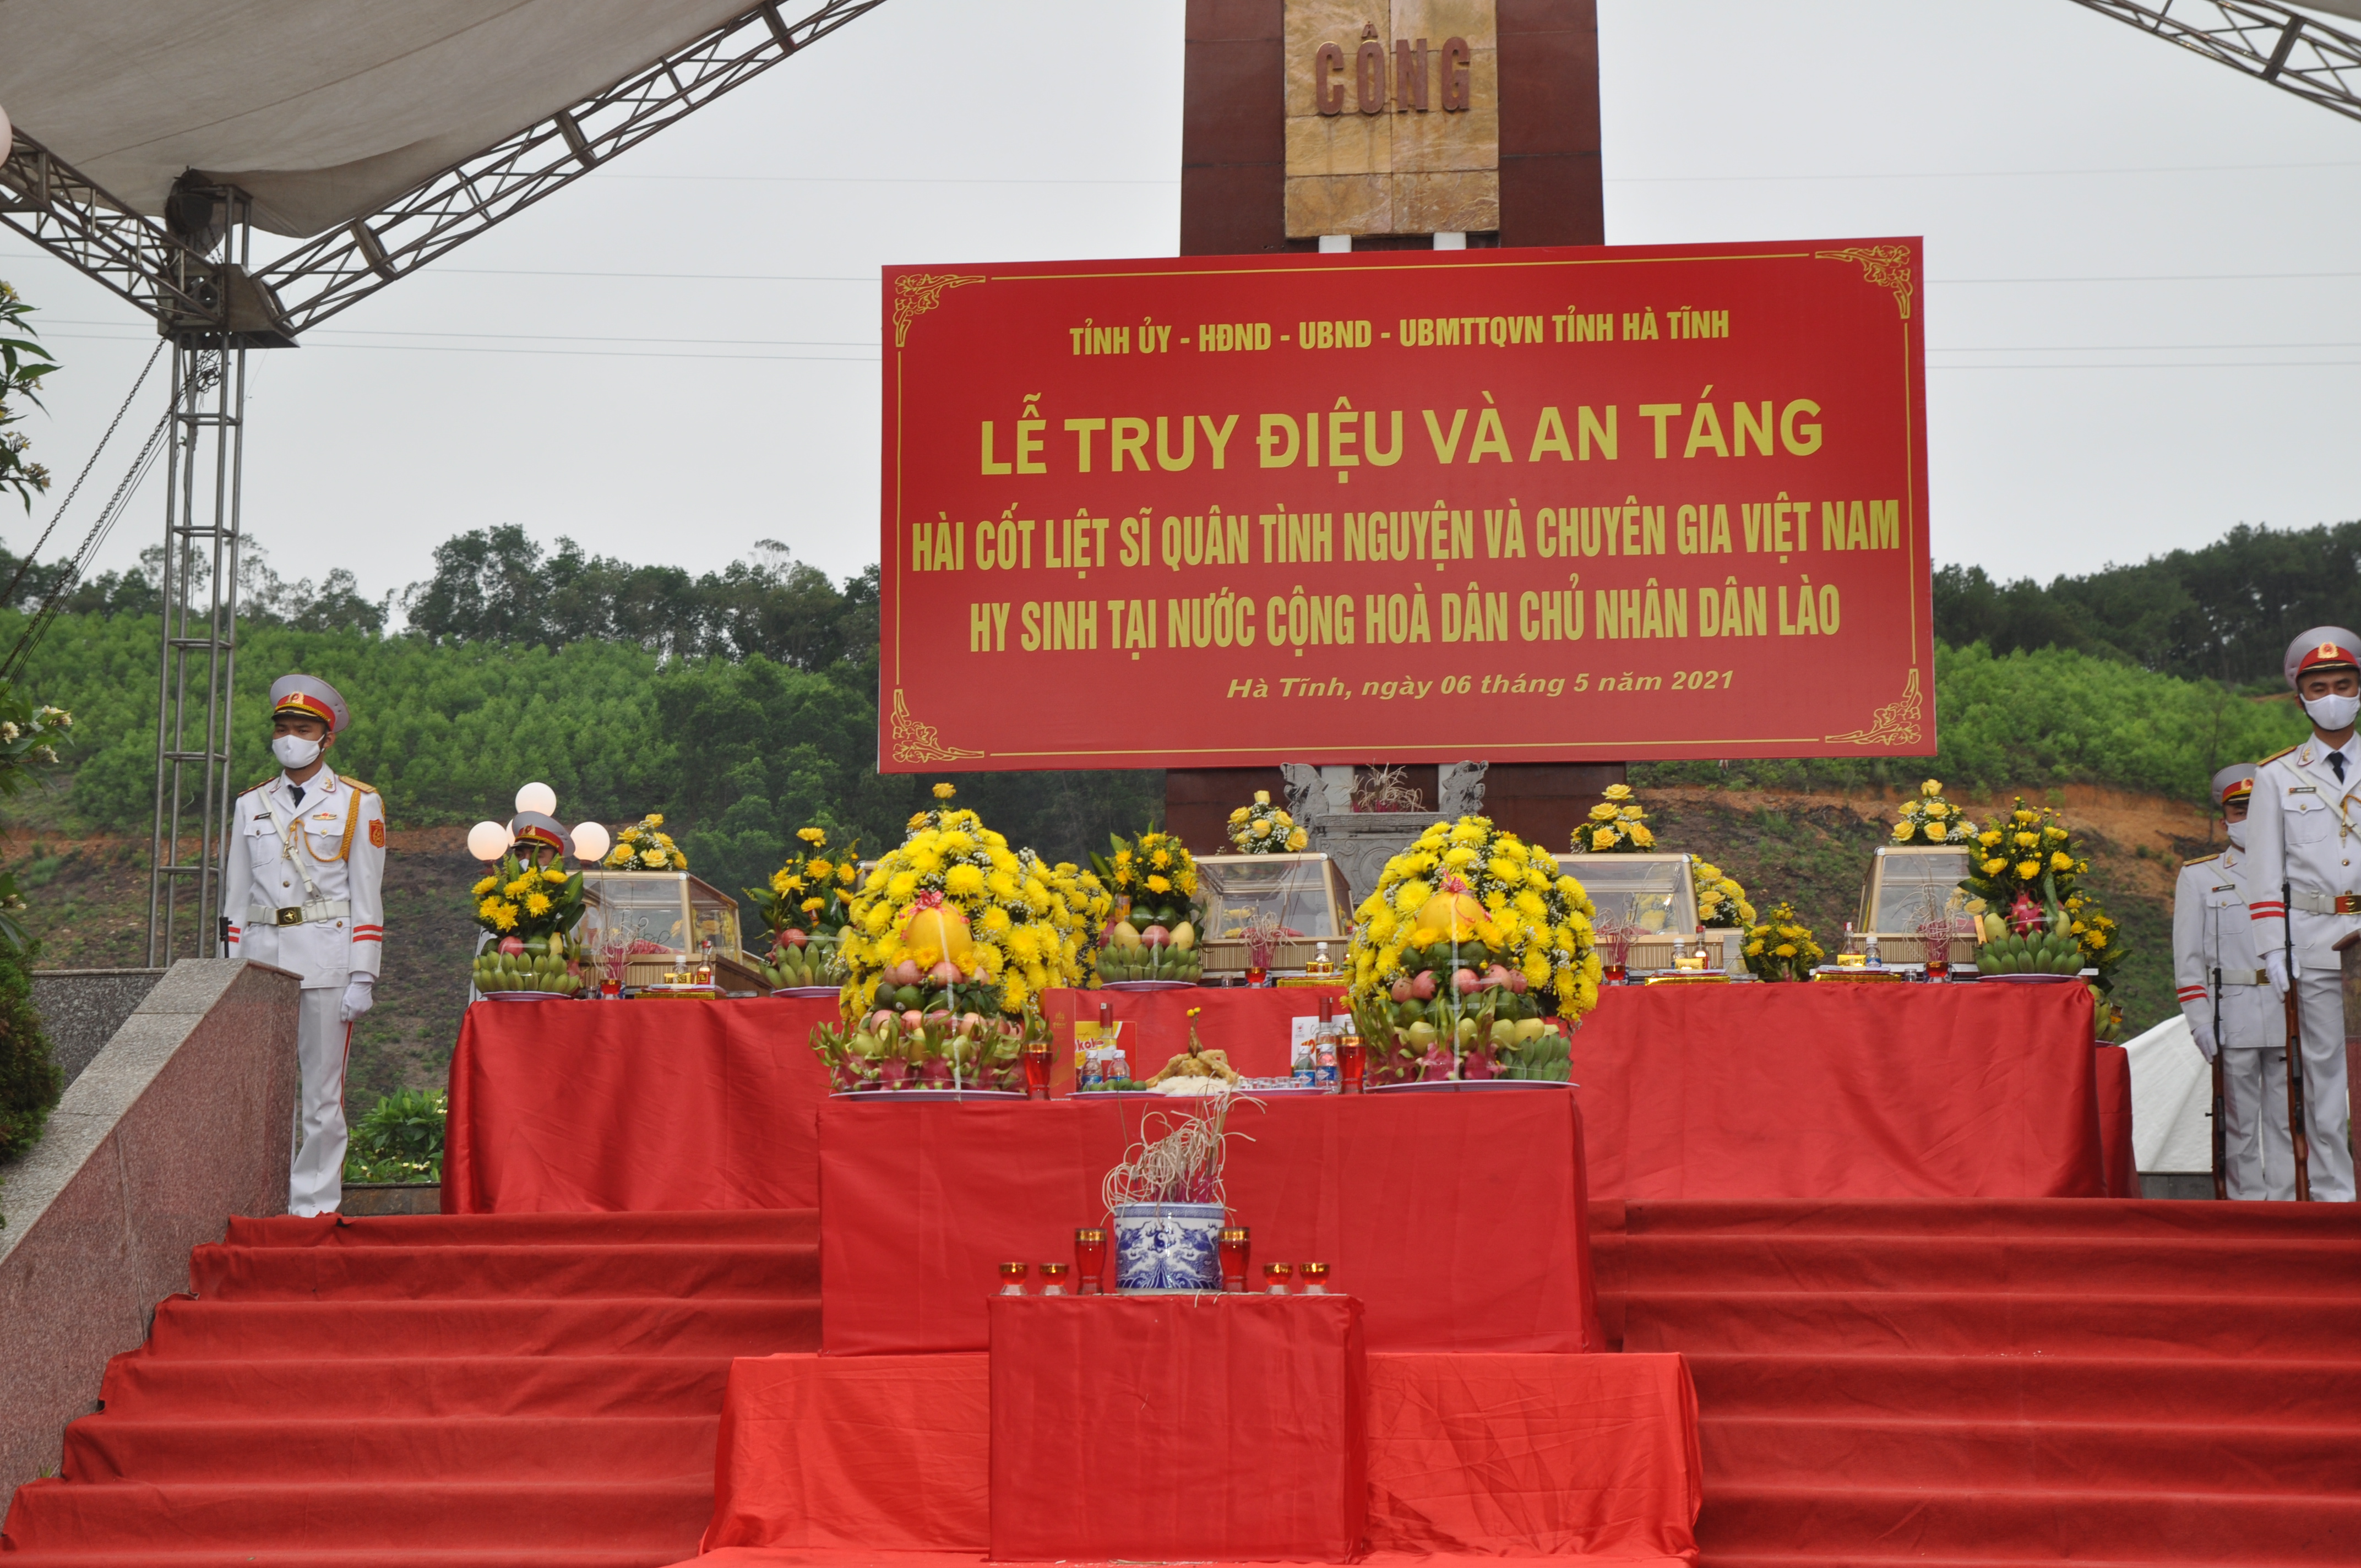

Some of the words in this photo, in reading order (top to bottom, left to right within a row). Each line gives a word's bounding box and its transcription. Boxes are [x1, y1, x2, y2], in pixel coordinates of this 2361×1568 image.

[1070, 318, 1129, 355] TỈNH
[1139, 317, 1171, 353] ỦY
[1199, 323, 1271, 351] HĐND
[1299, 320, 1372, 349] UBND
[1400, 316, 1543, 347] UBMTTQVN
[1552, 305, 1613, 342] TỈNH
[1623, 307, 1658, 340] HÀ
[1667, 306, 1728, 339] TĨNH
[982, 393, 1047, 475] LỄ
[1064, 415, 1239, 472] TRUY
[1256, 396, 1403, 483] ĐIỆU
[1422, 391, 1513, 464] VÀ
[1528, 405, 1617, 462] AN
[1639, 385, 1822, 459] TÁNG
[913, 511, 964, 571] HÀI
[976, 503, 1035, 570] CỐT
[1046, 508, 1109, 579] LIỆT
[1120, 507, 1152, 567] SĨ
[1162, 505, 1249, 571] QUÂN
[1259, 503, 1332, 563] TÌNH
[1344, 499, 1473, 571] NGUYỆN
[1483, 498, 1526, 558] VÀ
[1536, 495, 1666, 558] CHUYÊN
[1677, 504, 1732, 555] GIA
[1741, 492, 1811, 563] VIỆT
[1822, 500, 1899, 551] NAM
[971, 603, 1010, 652] HY
[1021, 601, 1097, 651] SINH
[1107, 600, 1156, 660] TẠI
[1168, 587, 1255, 647] NƯỚC
[1267, 585, 1354, 657] CỘNG
[1366, 582, 1431, 644] HOÀ
[1441, 581, 1508, 642] DÂN
[1520, 573, 1584, 641] CHỦ
[1596, 578, 1688, 639] NHÂN
[1699, 576, 1767, 637] DÂN
[1778, 574, 1840, 635] LÀO
[1227, 678, 1268, 698] Hà
[1280, 677, 1352, 700] Tĩnh,
[1362, 676, 1433, 700] ngày
[1441, 675, 1472, 694] 06
[1481, 673, 1565, 697] tháng
[1574, 673, 1589, 692] 5
[1598, 672, 1662, 691] năm
[1671, 671, 1733, 690] 2021
